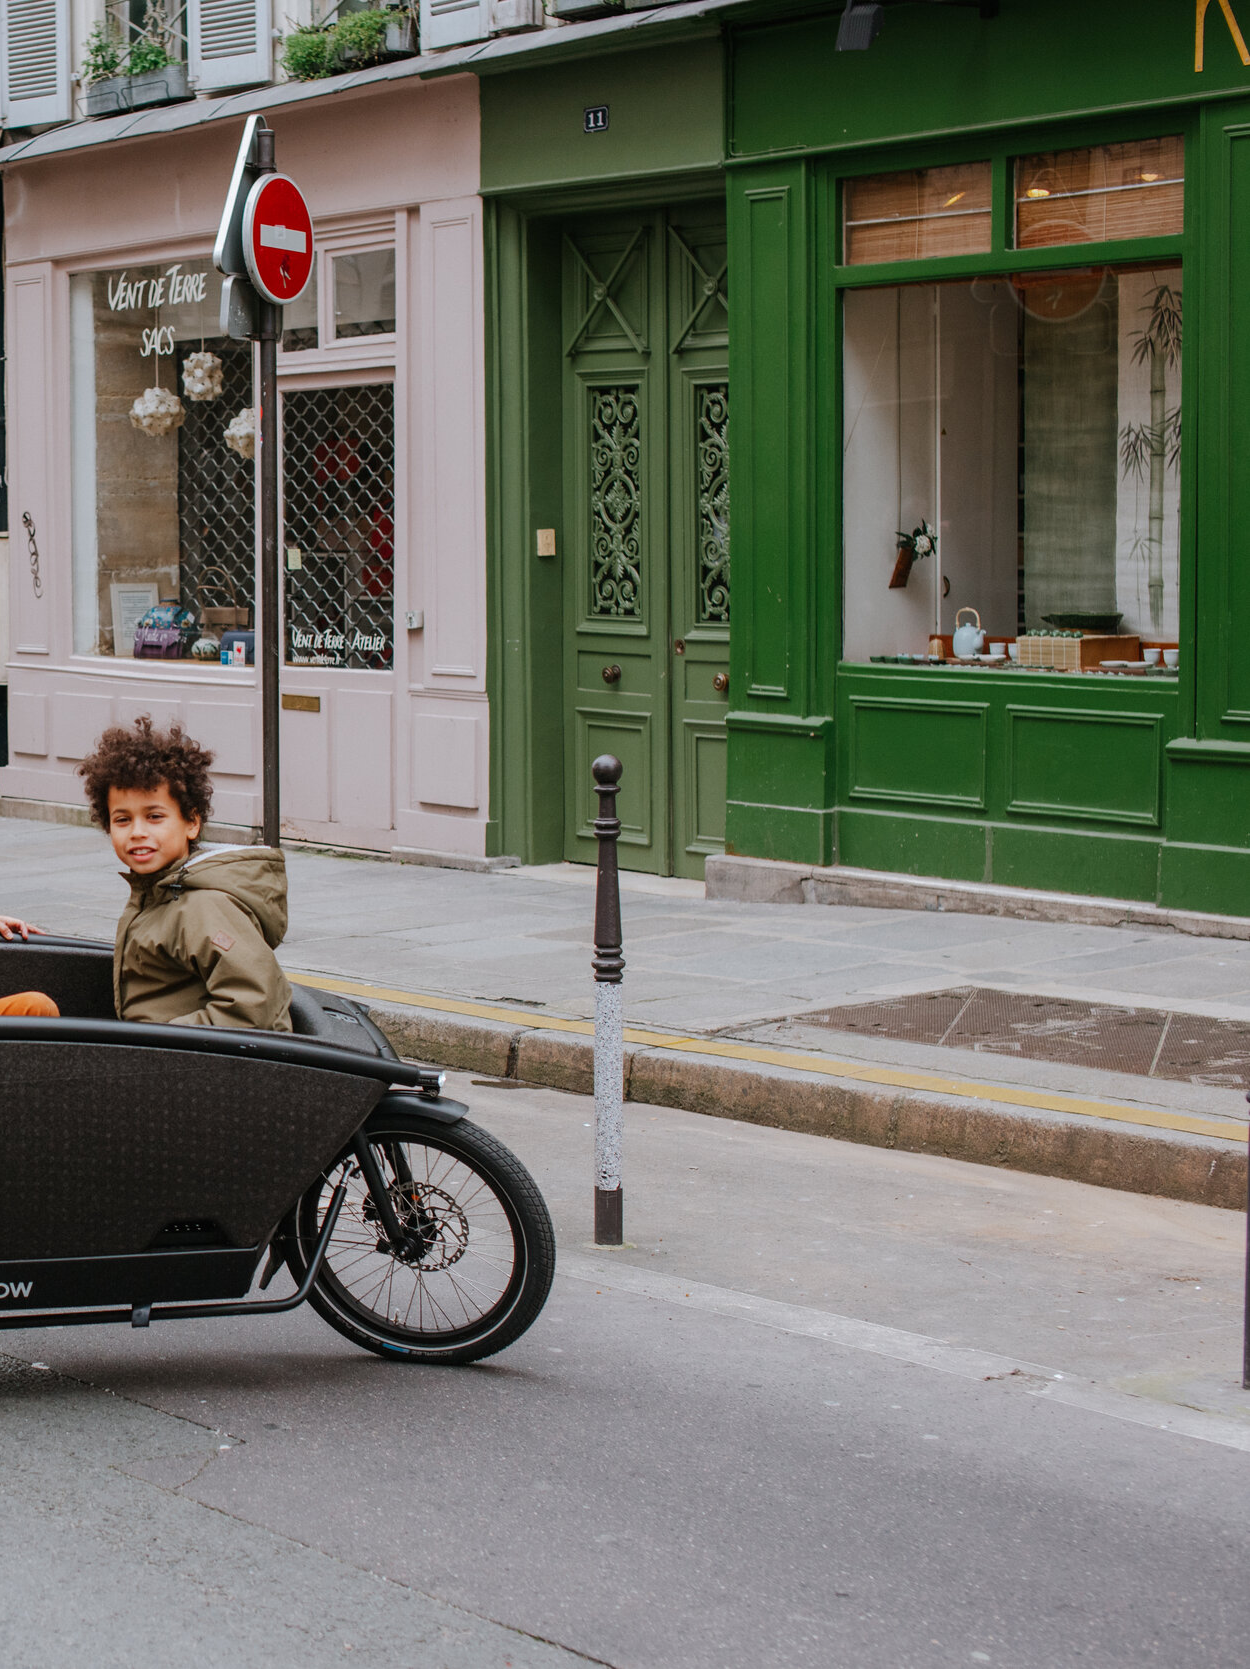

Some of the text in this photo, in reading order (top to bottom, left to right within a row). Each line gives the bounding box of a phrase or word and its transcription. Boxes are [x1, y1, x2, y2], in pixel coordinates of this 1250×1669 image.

[588, 111, 604, 128] 11
[108, 263, 207, 311] VENT DE TERRE
[140, 325, 175, 357] SACS
[292, 628, 386, 651] VENT DE TERRE ATELIER
